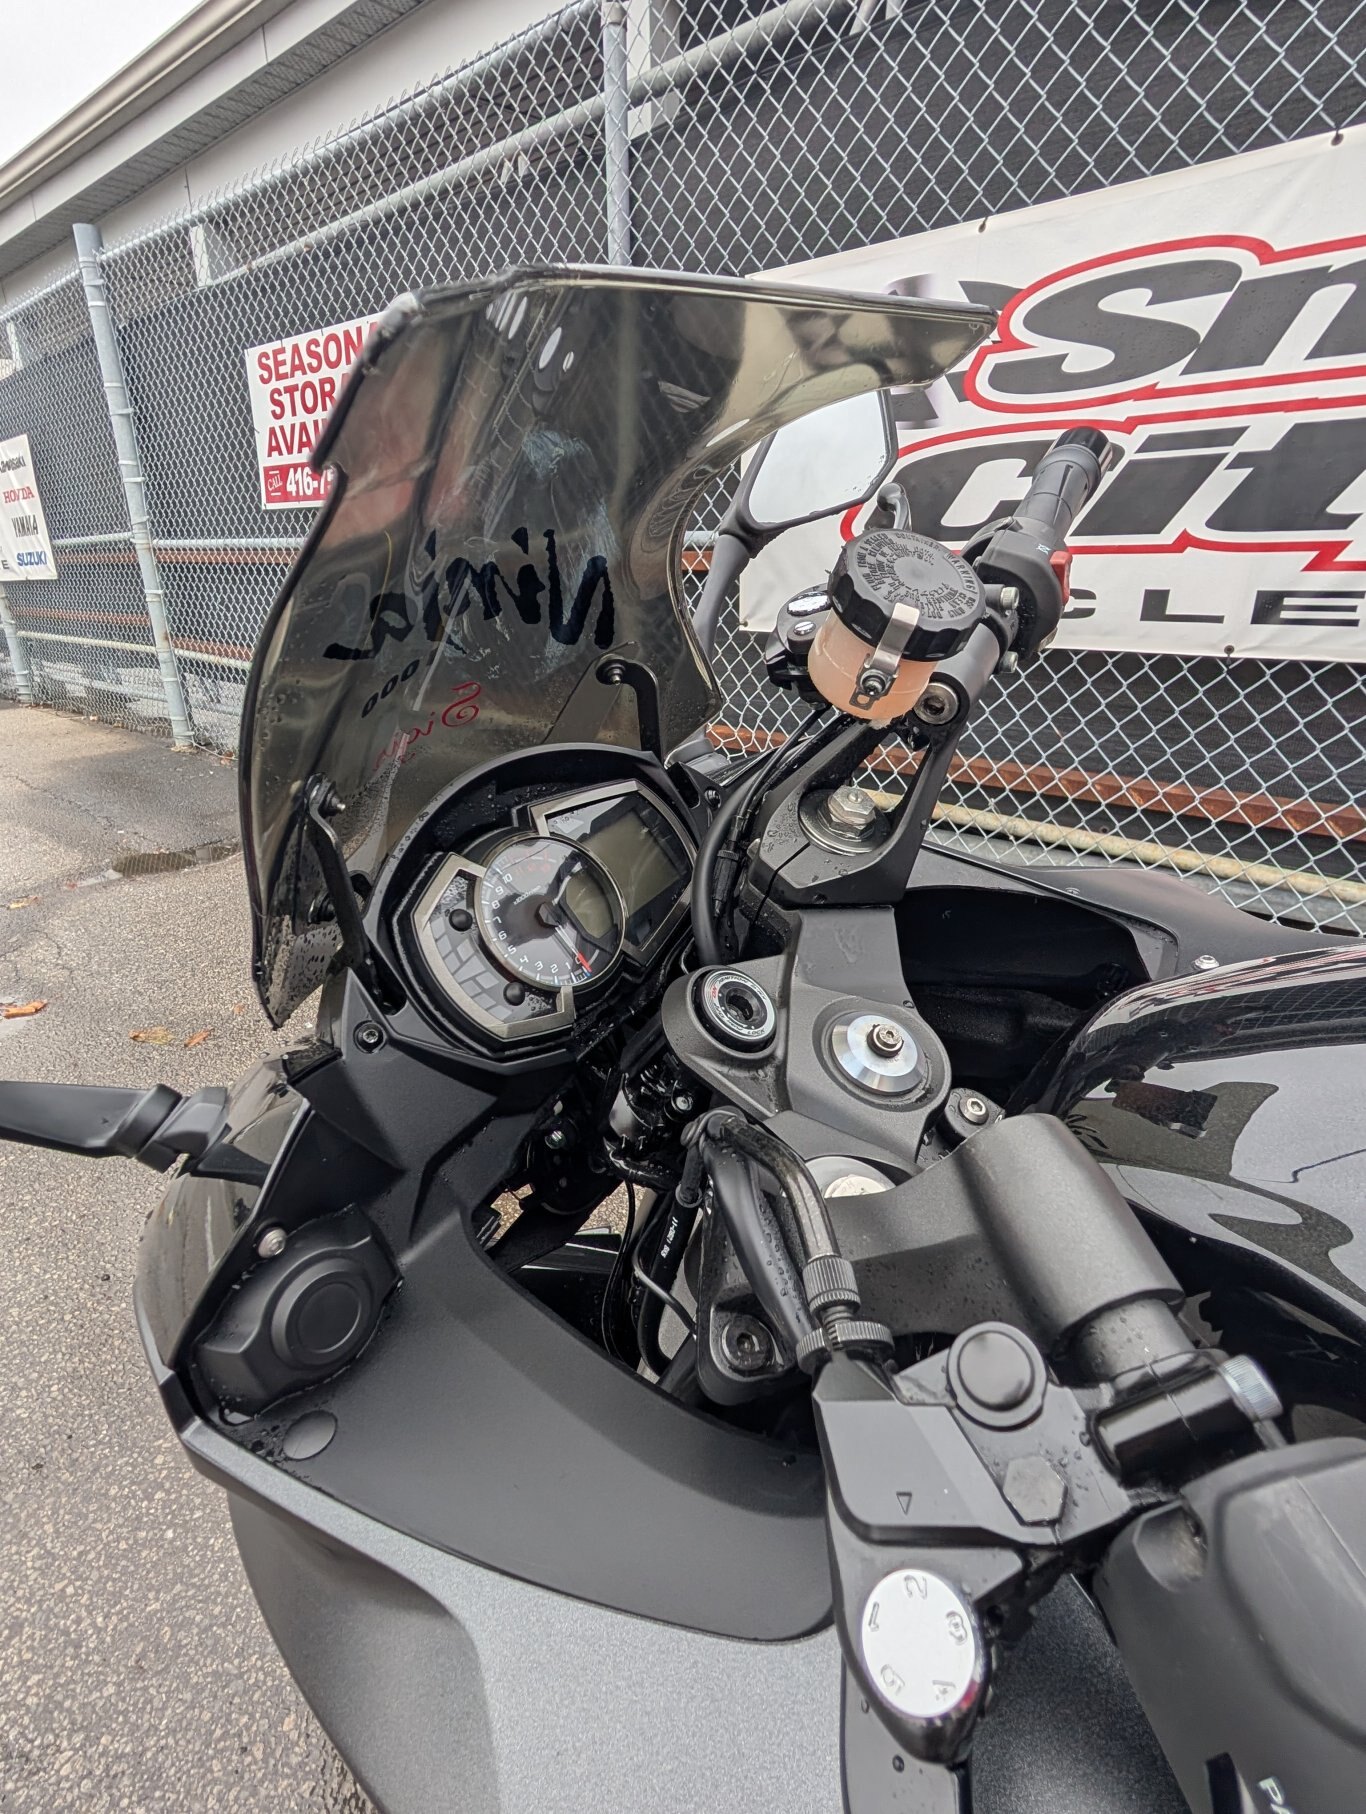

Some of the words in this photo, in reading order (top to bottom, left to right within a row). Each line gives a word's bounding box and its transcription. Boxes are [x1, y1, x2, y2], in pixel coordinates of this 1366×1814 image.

[269, 373, 346, 420] STOR
[267, 418, 328, 458] AVAI
[267, 475, 283, 491] CALL
[17, 550, 47, 566] SUZUKI
[503, 873, 513, 884] 10
[495, 886, 504, 895] 9
[491, 900, 501, 909] 8
[493, 916, 502, 924] 7
[498, 931, 507, 941] 6
[507, 944, 517, 955] 5
[519, 955, 529, 963] 4
[534, 961, 544, 971] 3
[550, 963, 559, 974] 2
[904, 1575, 928, 1600] 2
[868, 1601, 880, 1632] 1
[946, 1610, 968, 1646] 3
[881, 1664, 905, 1696] 5
